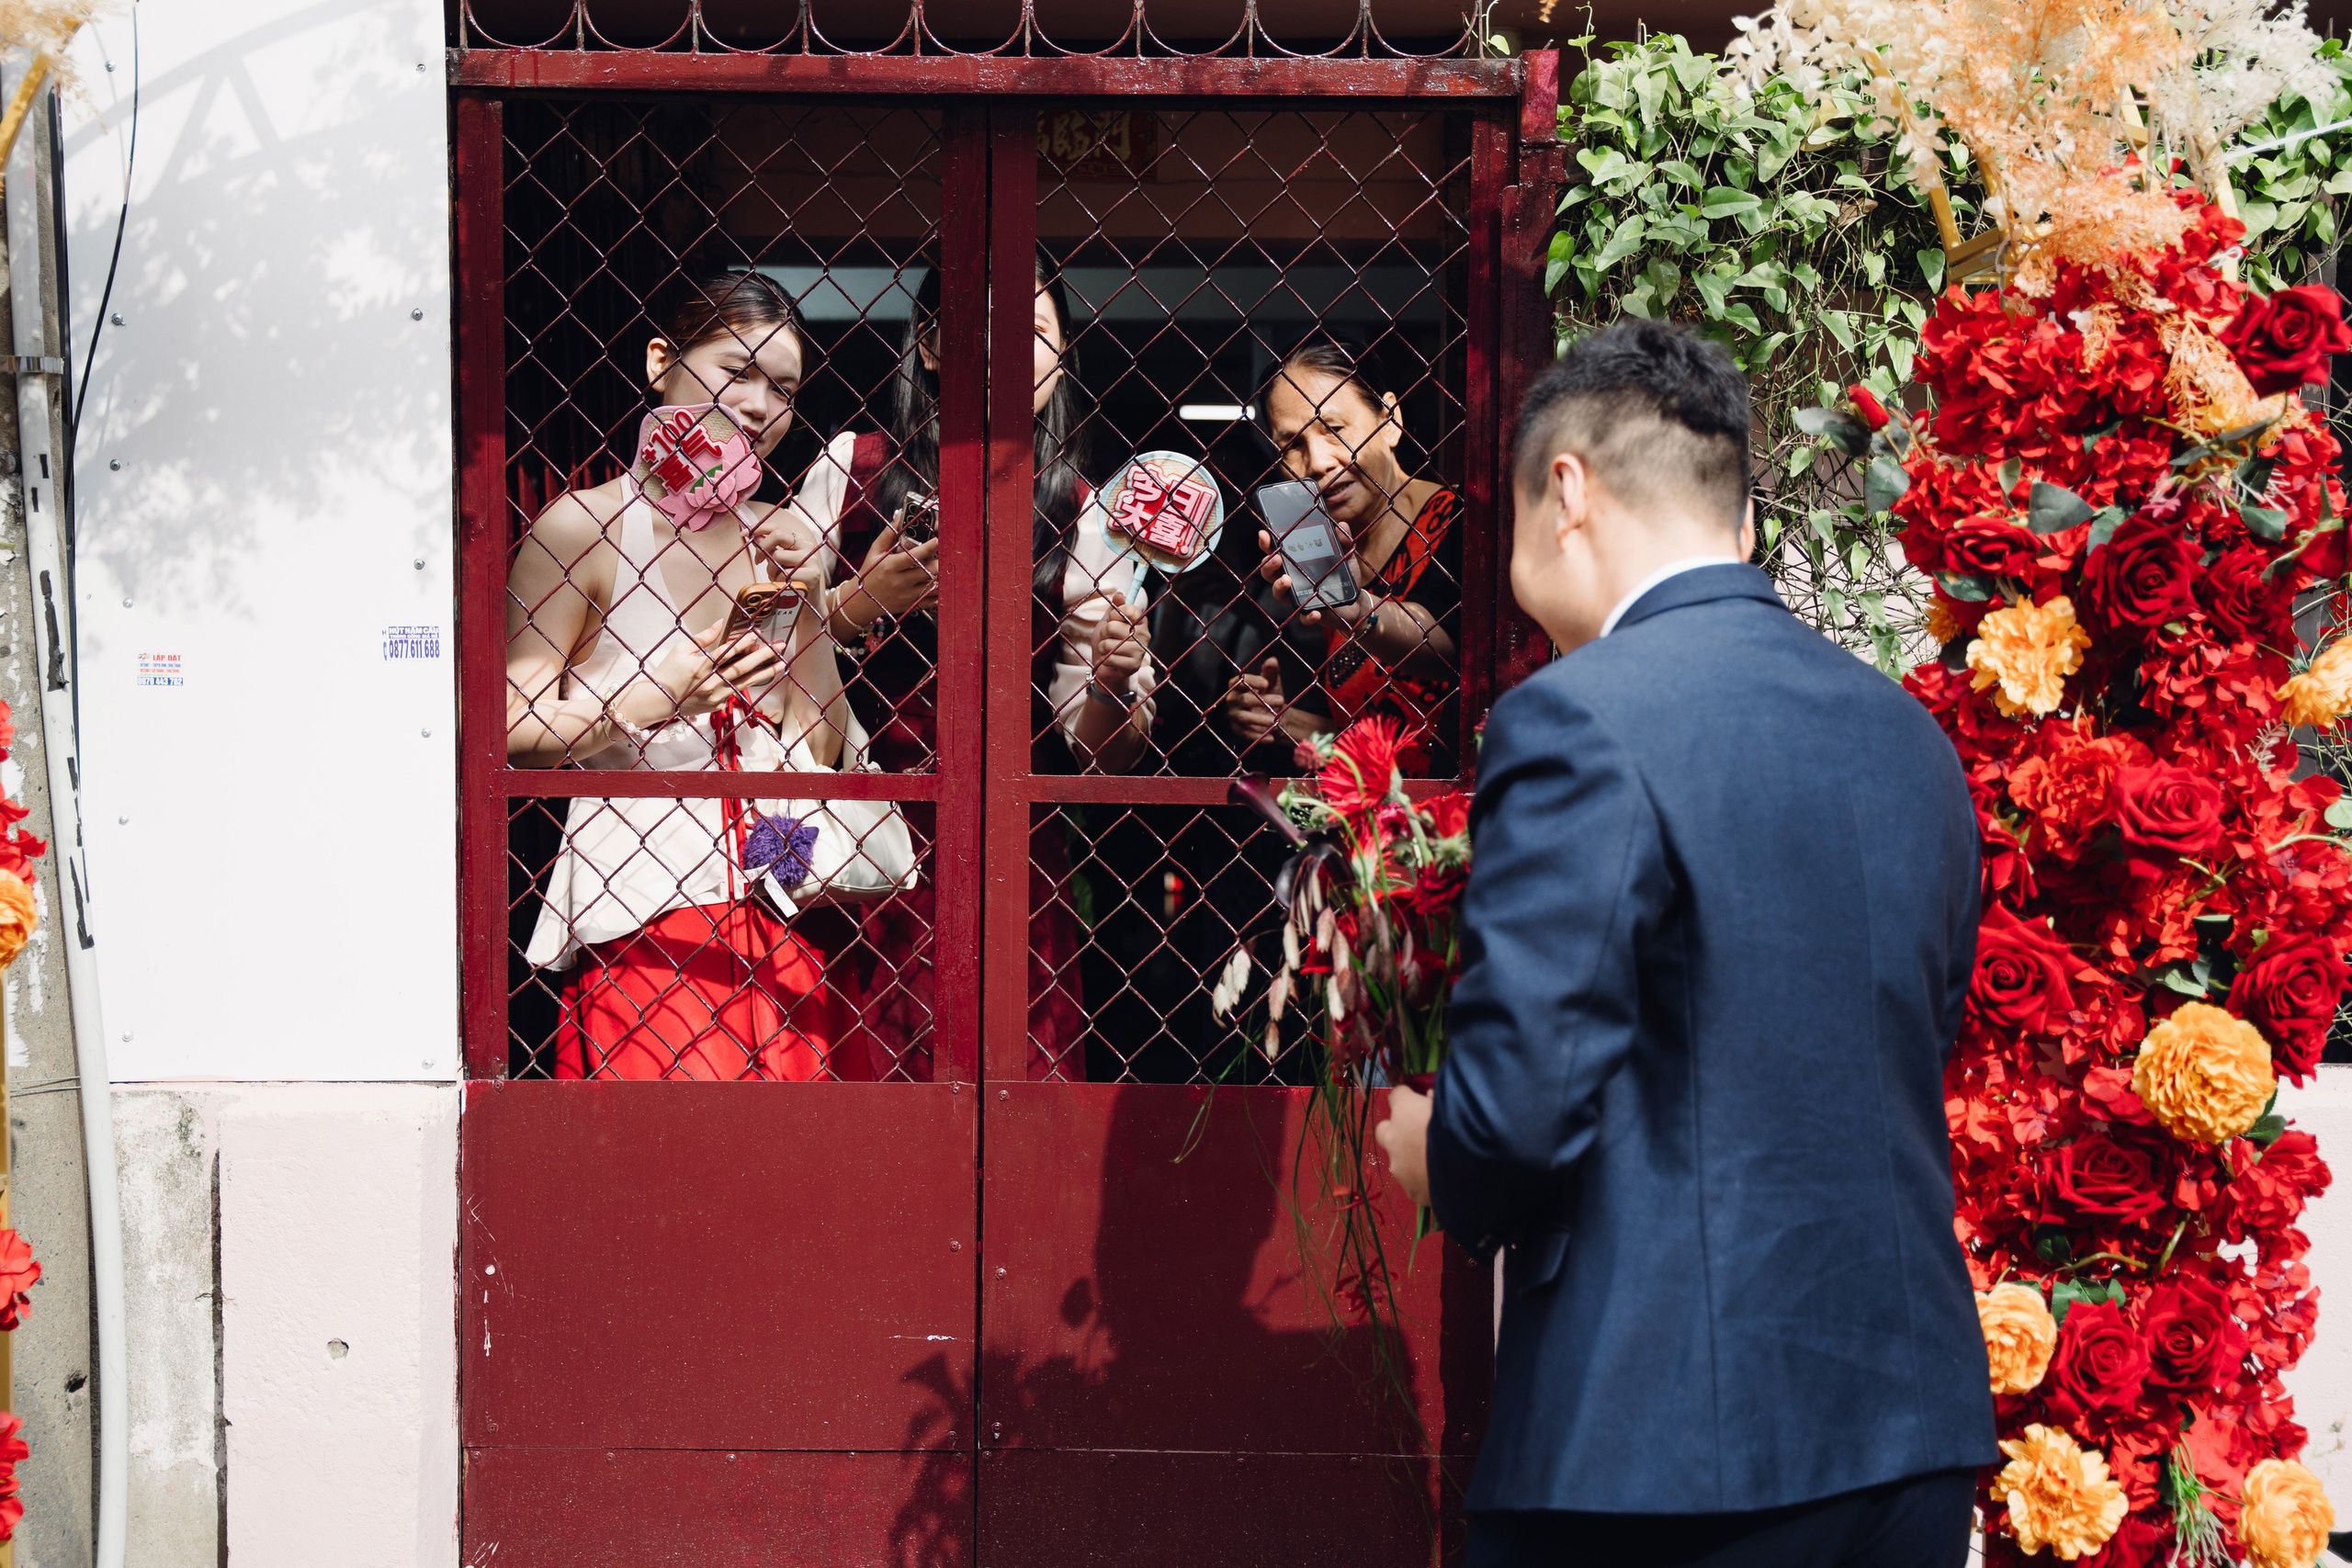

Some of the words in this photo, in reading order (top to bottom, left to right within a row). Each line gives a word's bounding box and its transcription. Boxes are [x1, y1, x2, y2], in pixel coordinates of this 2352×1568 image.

[643, 409, 695, 462] +100
[656, 428, 723, 493] 喜气
[1132, 469, 1201, 517] 今日
[390, 639, 439, 659] 0877.611.688
